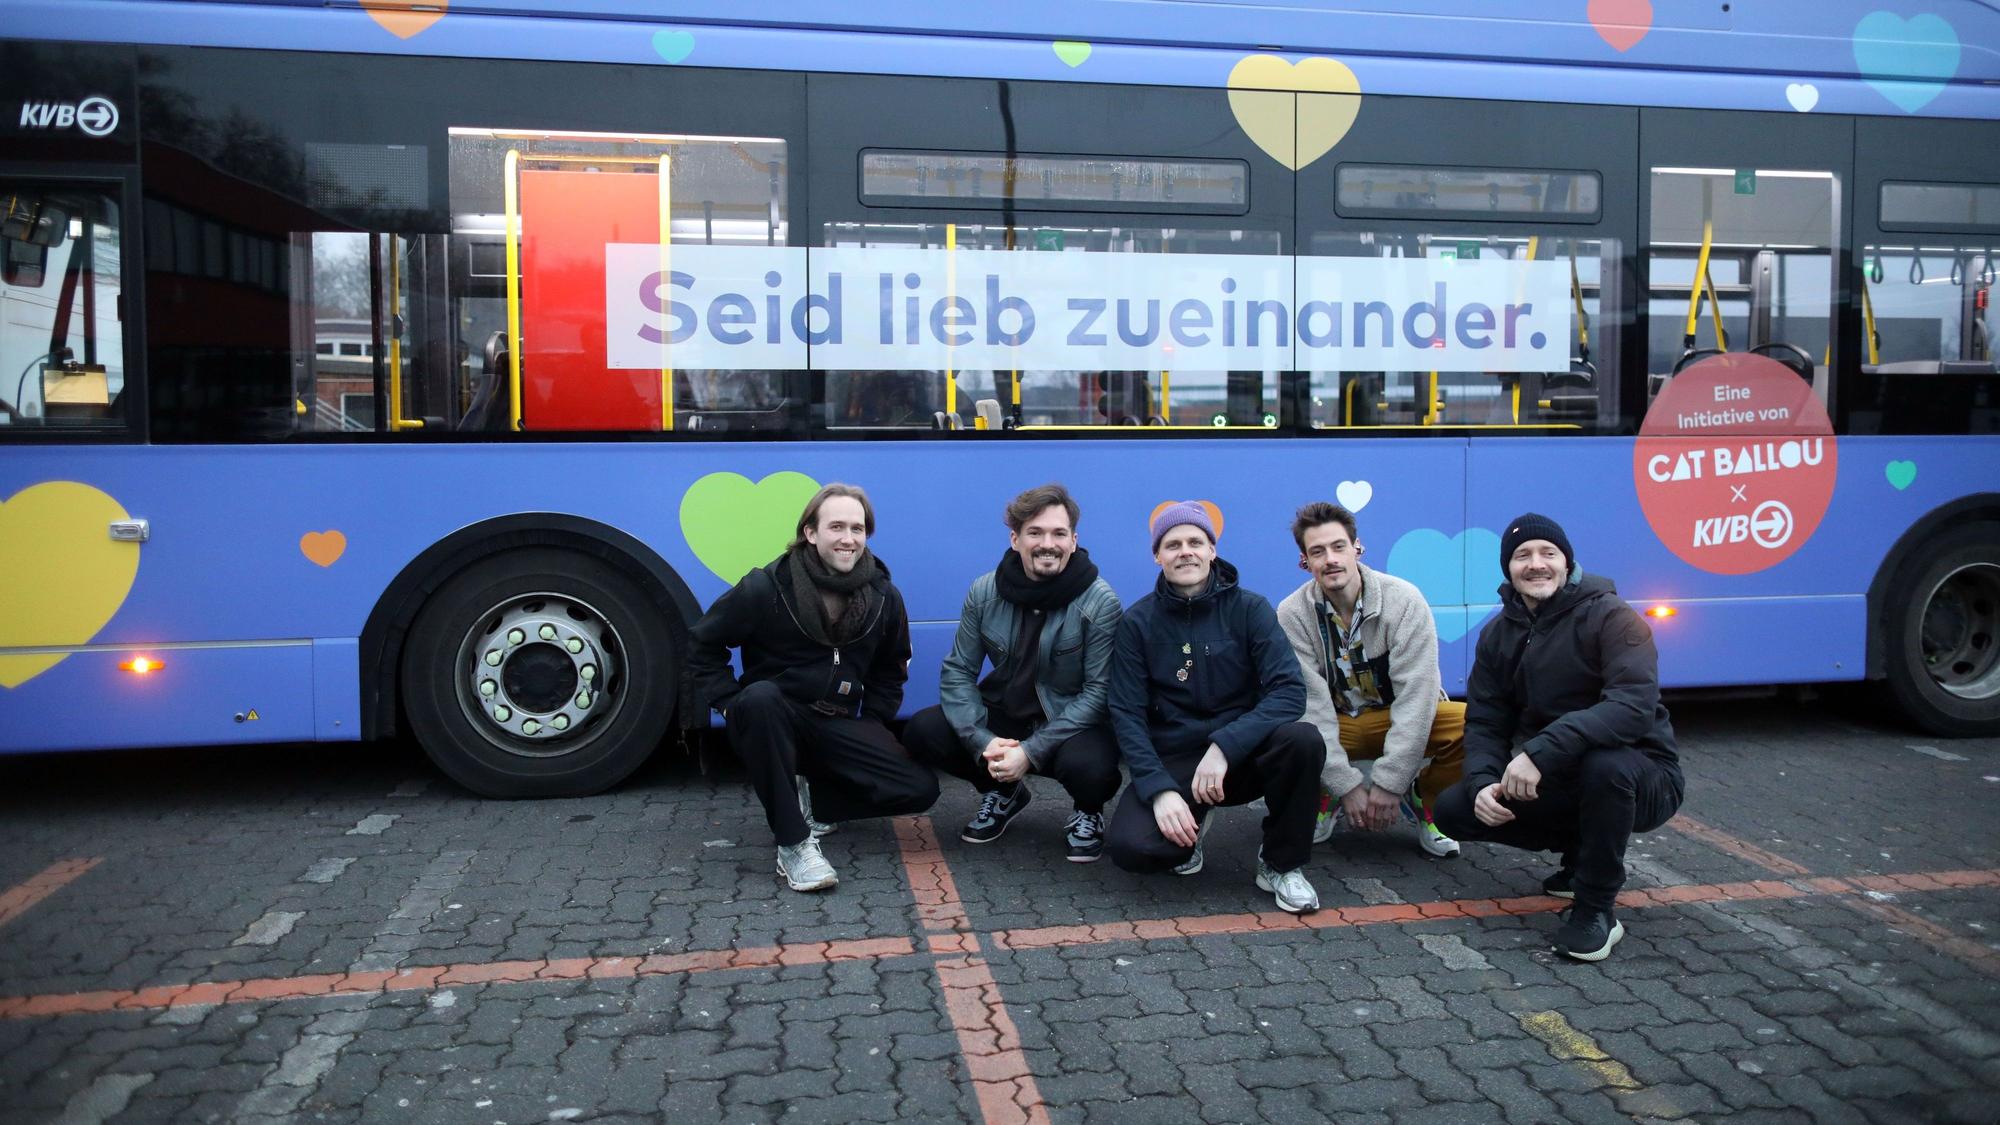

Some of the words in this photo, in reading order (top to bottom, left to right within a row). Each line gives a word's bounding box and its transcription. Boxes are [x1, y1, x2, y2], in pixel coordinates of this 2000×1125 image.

[20, 102, 76, 127] KVB
[637, 270, 843, 345] Seid
[879, 272, 1036, 347] lieb
[1066, 277, 1548, 350] zueinander.
[1714, 385, 1751, 402] Eine
[1678, 409, 1755, 429] Initiative
[1758, 407, 1789, 421] von
[1648, 450, 1706, 483] CAT
[1713, 437, 1824, 477] BALLOU
[1693, 514, 1750, 548] KVB
